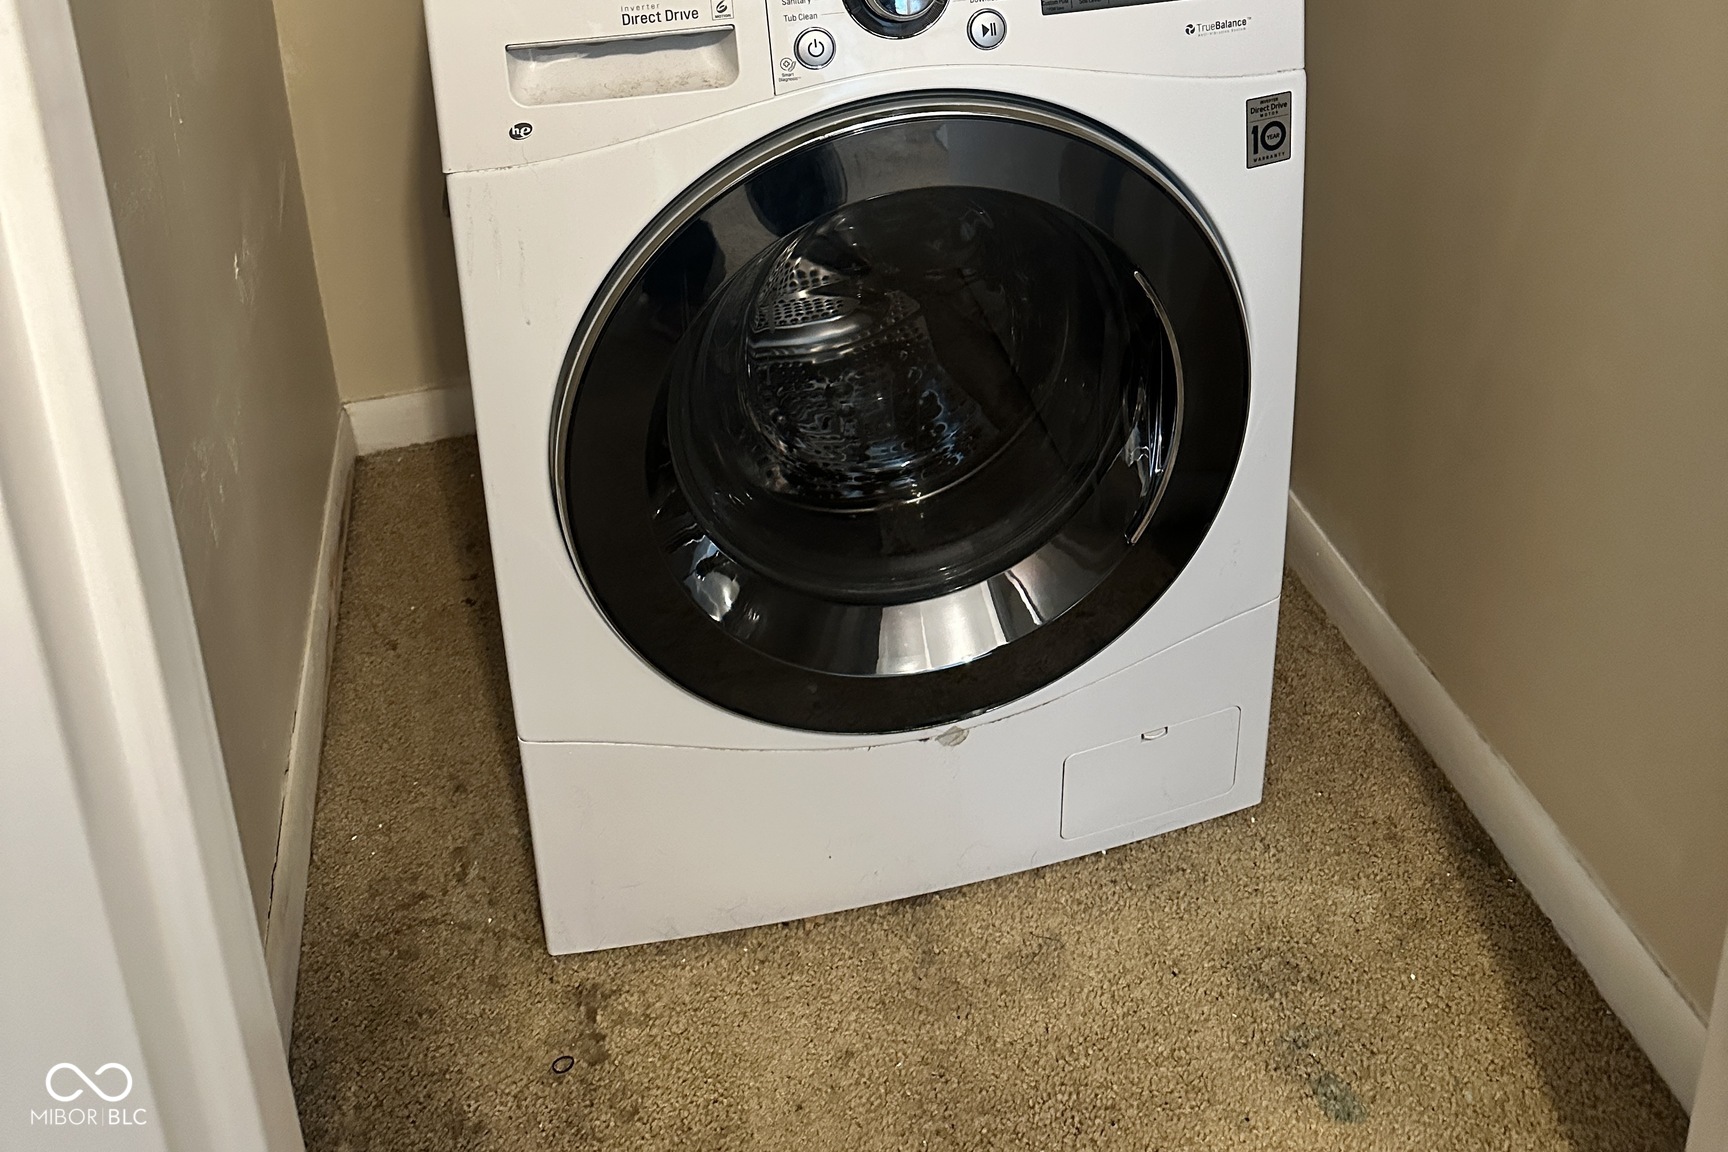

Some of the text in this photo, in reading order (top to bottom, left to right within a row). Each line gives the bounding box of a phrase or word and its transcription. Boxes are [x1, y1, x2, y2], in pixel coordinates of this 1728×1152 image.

[620, 3, 660, 12] Inverter
[622, 8, 699, 26] Direct Drive
[783, 12, 818, 22] Tub Clean
[1197, 19, 1247, 32] TrueBalance
[1250, 102, 1288, 115] Direct Drive
[510, 124, 533, 140] he
[1252, 121, 1286, 155] 10
[1267, 132, 1280, 140] YEAR
[1254, 152, 1285, 162] WARRANTY
